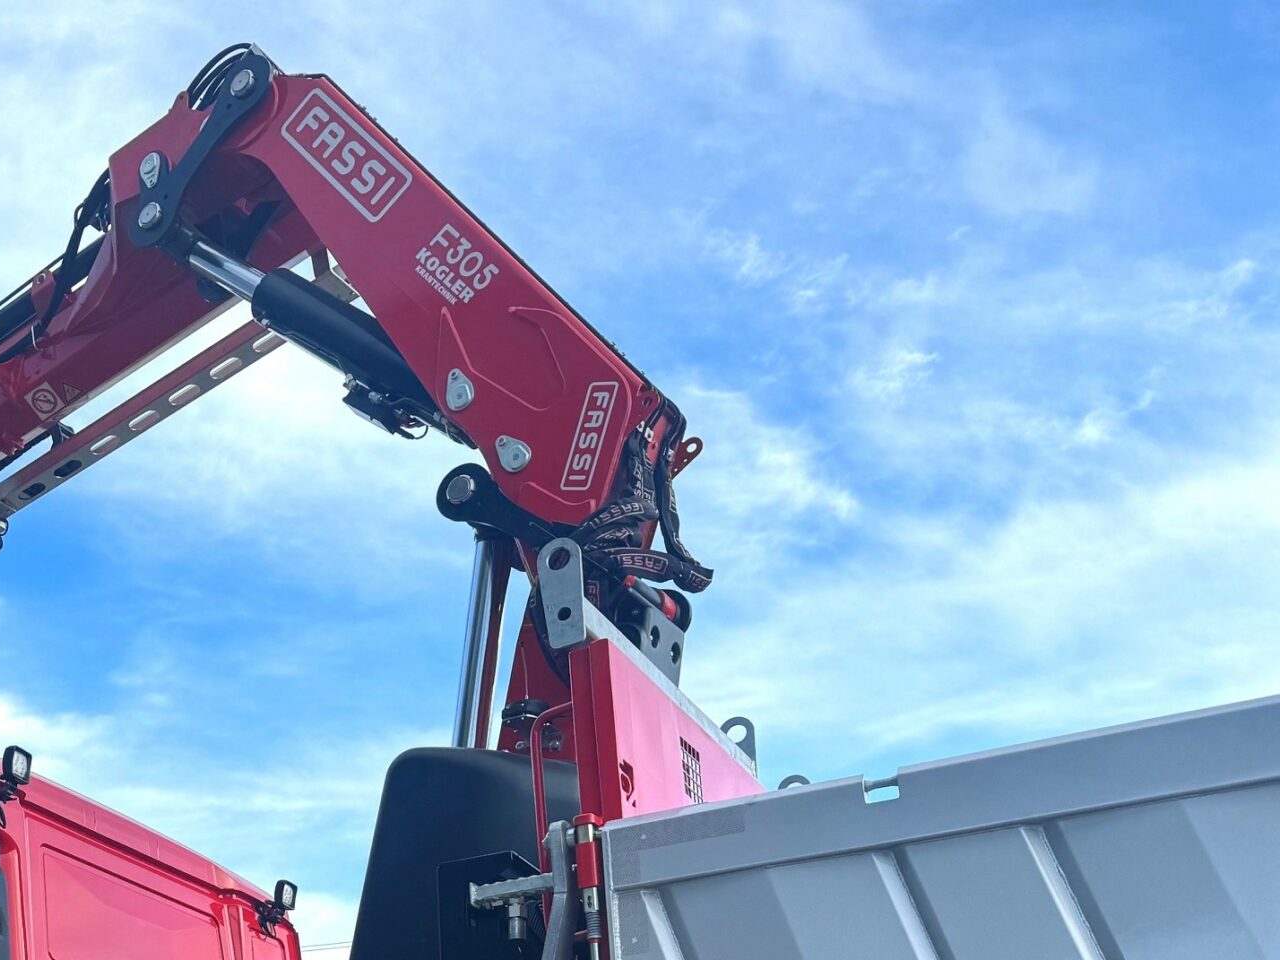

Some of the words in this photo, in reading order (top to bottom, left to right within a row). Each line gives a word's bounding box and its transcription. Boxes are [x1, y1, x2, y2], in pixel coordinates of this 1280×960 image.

[296, 106, 395, 205] FASSI
[415, 247, 475, 304] KOGLER
[415, 265, 458, 305] KRANTECHNIK
[429, 223, 500, 290] F305
[568, 391, 610, 480] FASSI
